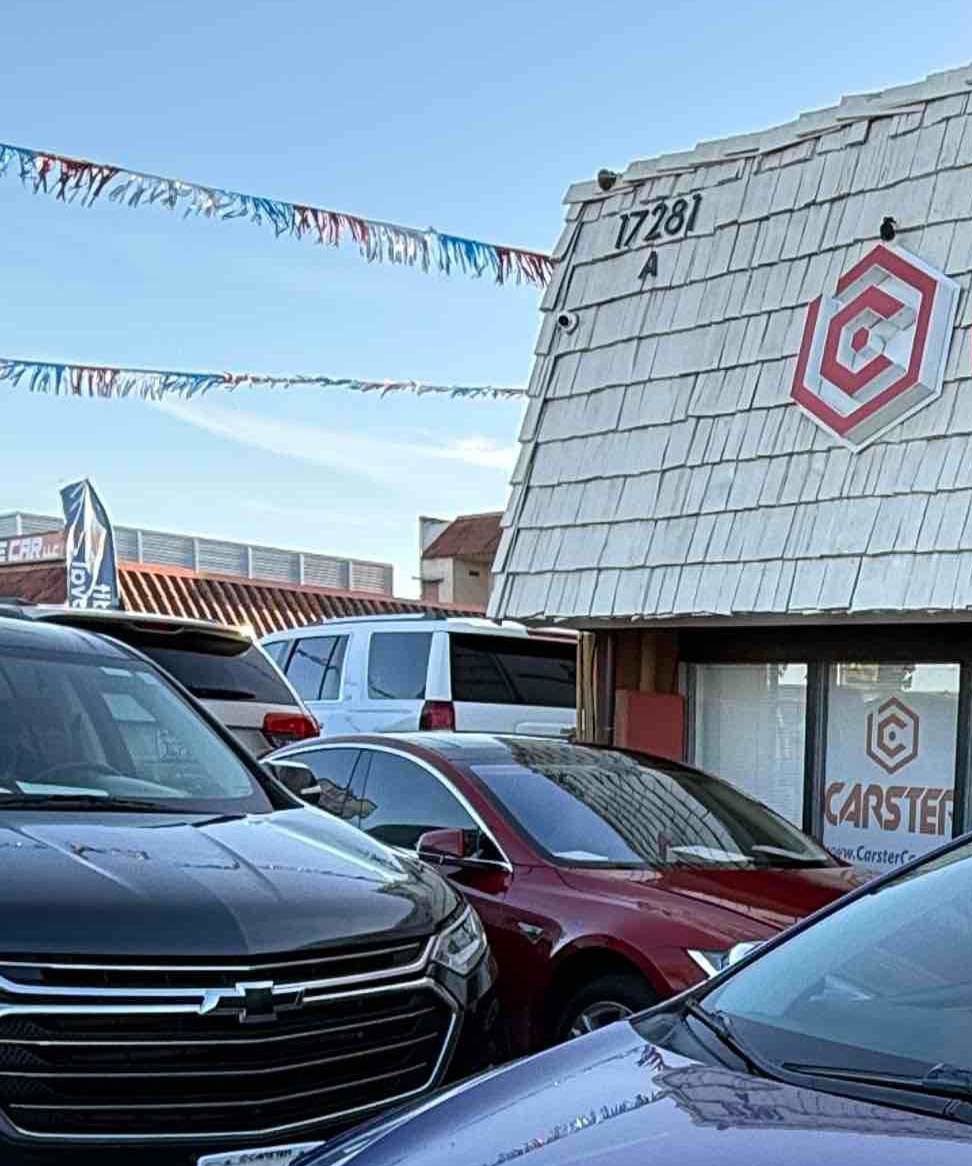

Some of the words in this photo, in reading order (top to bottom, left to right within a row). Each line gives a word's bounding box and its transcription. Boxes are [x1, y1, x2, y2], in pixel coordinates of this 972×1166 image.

[614, 193, 702, 249] 17281
[638, 250, 658, 280] A
[8, 536, 42, 561] CAR
